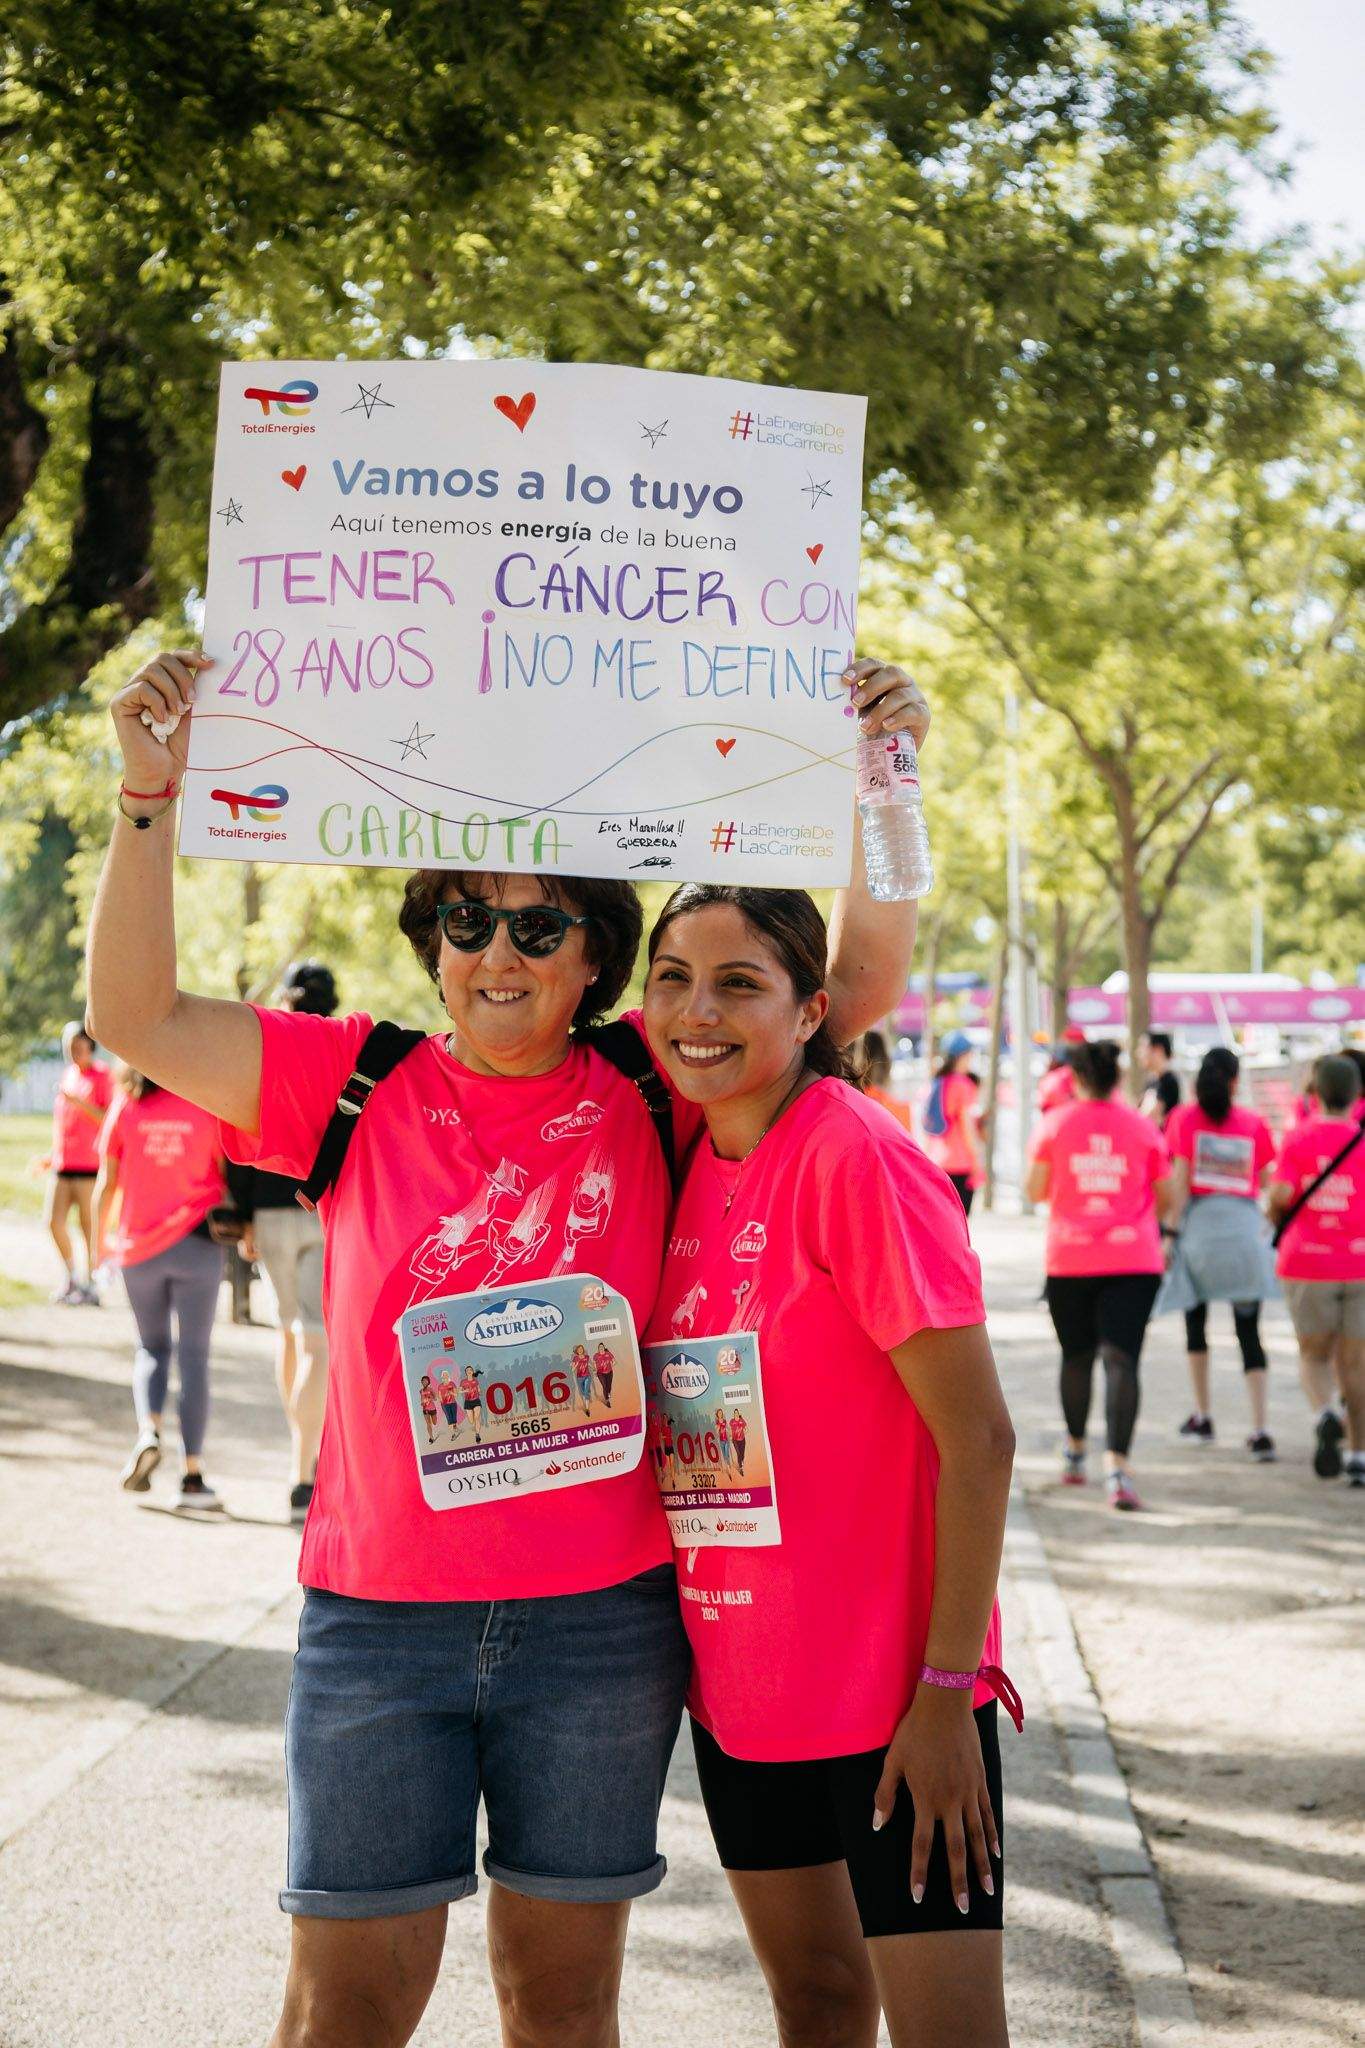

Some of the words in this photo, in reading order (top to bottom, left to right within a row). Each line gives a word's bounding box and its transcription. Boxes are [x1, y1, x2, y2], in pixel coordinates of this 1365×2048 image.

[241, 423, 316, 435] TotalEnergies
[757, 428, 844, 455] LasCarreras
[332, 458, 499, 499] Vamos
[517, 471, 545, 501] a
[565, 463, 611, 504] lo
[629, 472, 743, 519] tuyo
[330, 513, 385, 536] Aquí
[392, 515, 492, 536] tenemos
[500, 520, 592, 543] energía
[600, 525, 629, 545] de
[637, 528, 656, 547] la
[665, 530, 737, 552] buena
[238, 550, 456, 609] TENER
[494, 545, 738, 626] CÁNCER
[761, 578, 857, 639] CON
[218, 628, 286, 708] 28
[592, 638, 662, 701] ME
[208, 826, 287, 842] TotalEnergies
[318, 803, 573, 863] CARLOTA
[616, 837, 678, 850] GUERRERA
[739, 839, 833, 858] LasCarreras
[412, 1320, 449, 1337] SUMA
[473, 1314, 558, 1342] ASTURIANA
[485, 1371, 572, 1416] 016
[510, 1417, 551, 1438] 5665
[444, 1447, 496, 1467] CARRERA
[498, 1443, 513, 1456] DE
[515, 1440, 530, 1454] LA
[532, 1433, 569, 1451] MUJER
[577, 1422, 620, 1441] MADRID
[676, 1431, 720, 1466] 016
[563, 1450, 627, 1473] Santander
[447, 1467, 520, 1494] OYSHO
[686, 1494, 698, 1506] DE
[698, 1493, 708, 1505] LA
[710, 1590, 722, 1605] LA
[722, 1590, 753, 1606] MUJER
